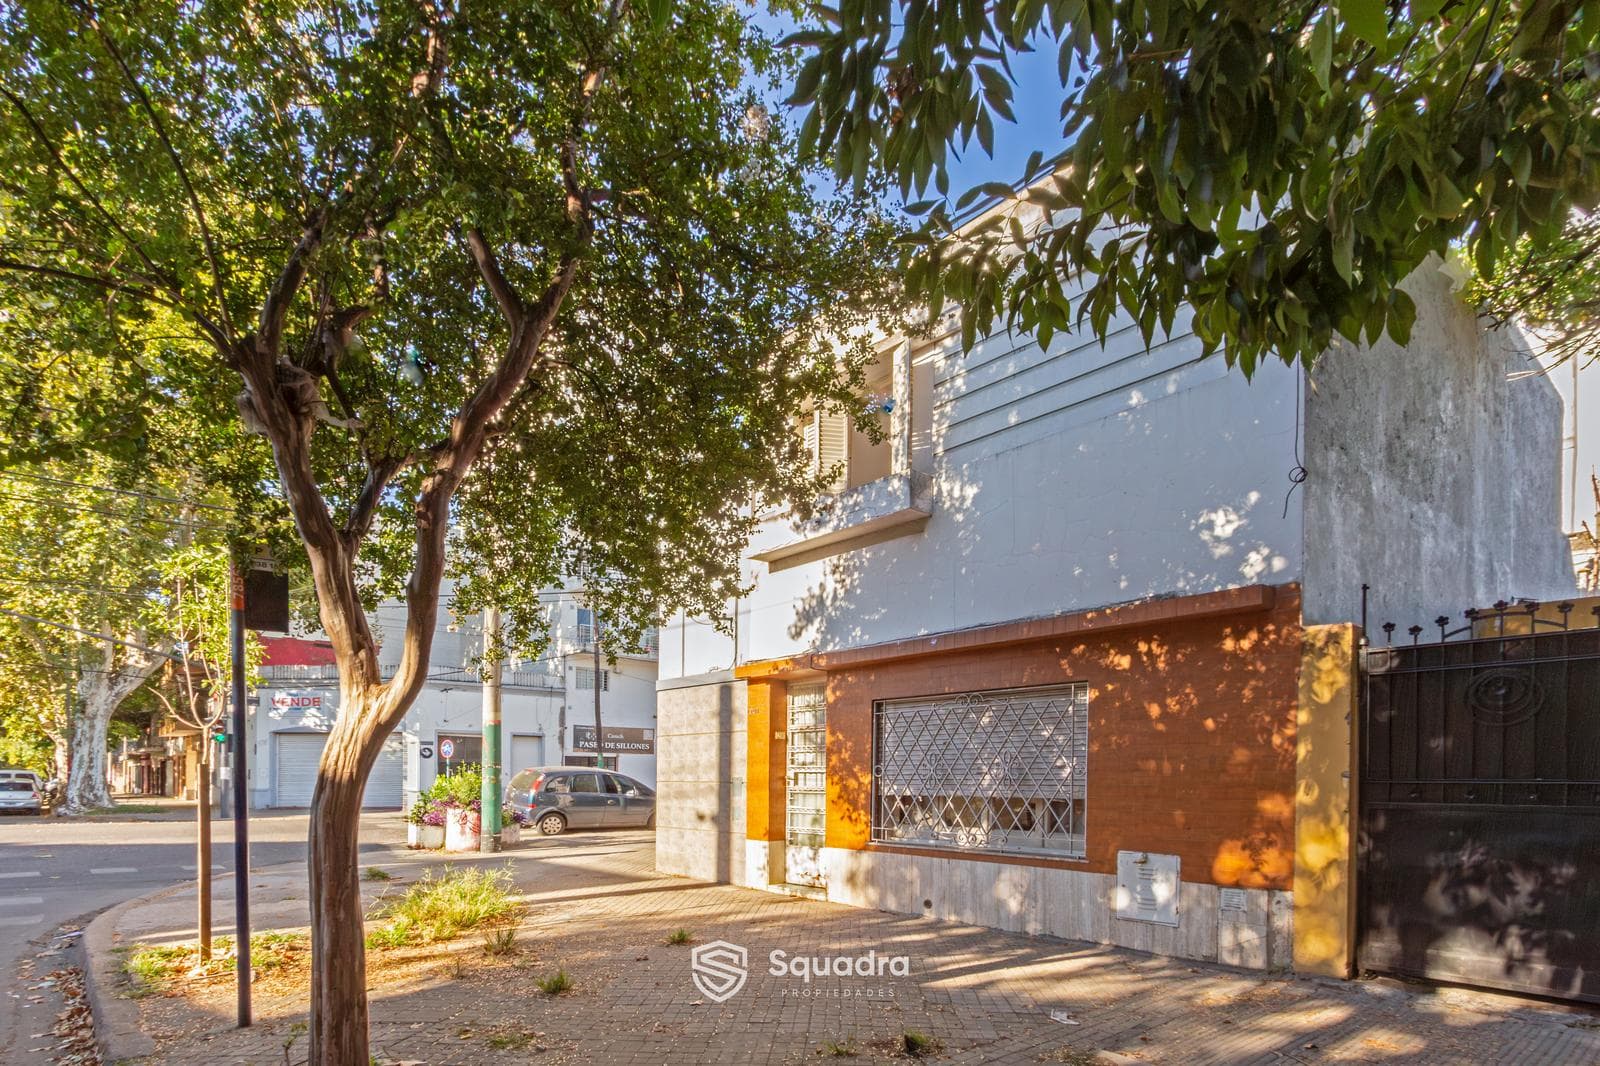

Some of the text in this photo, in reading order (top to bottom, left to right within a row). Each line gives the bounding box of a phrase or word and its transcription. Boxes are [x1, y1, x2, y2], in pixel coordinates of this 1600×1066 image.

[579, 741, 650, 751] PASE DE SILLONES
